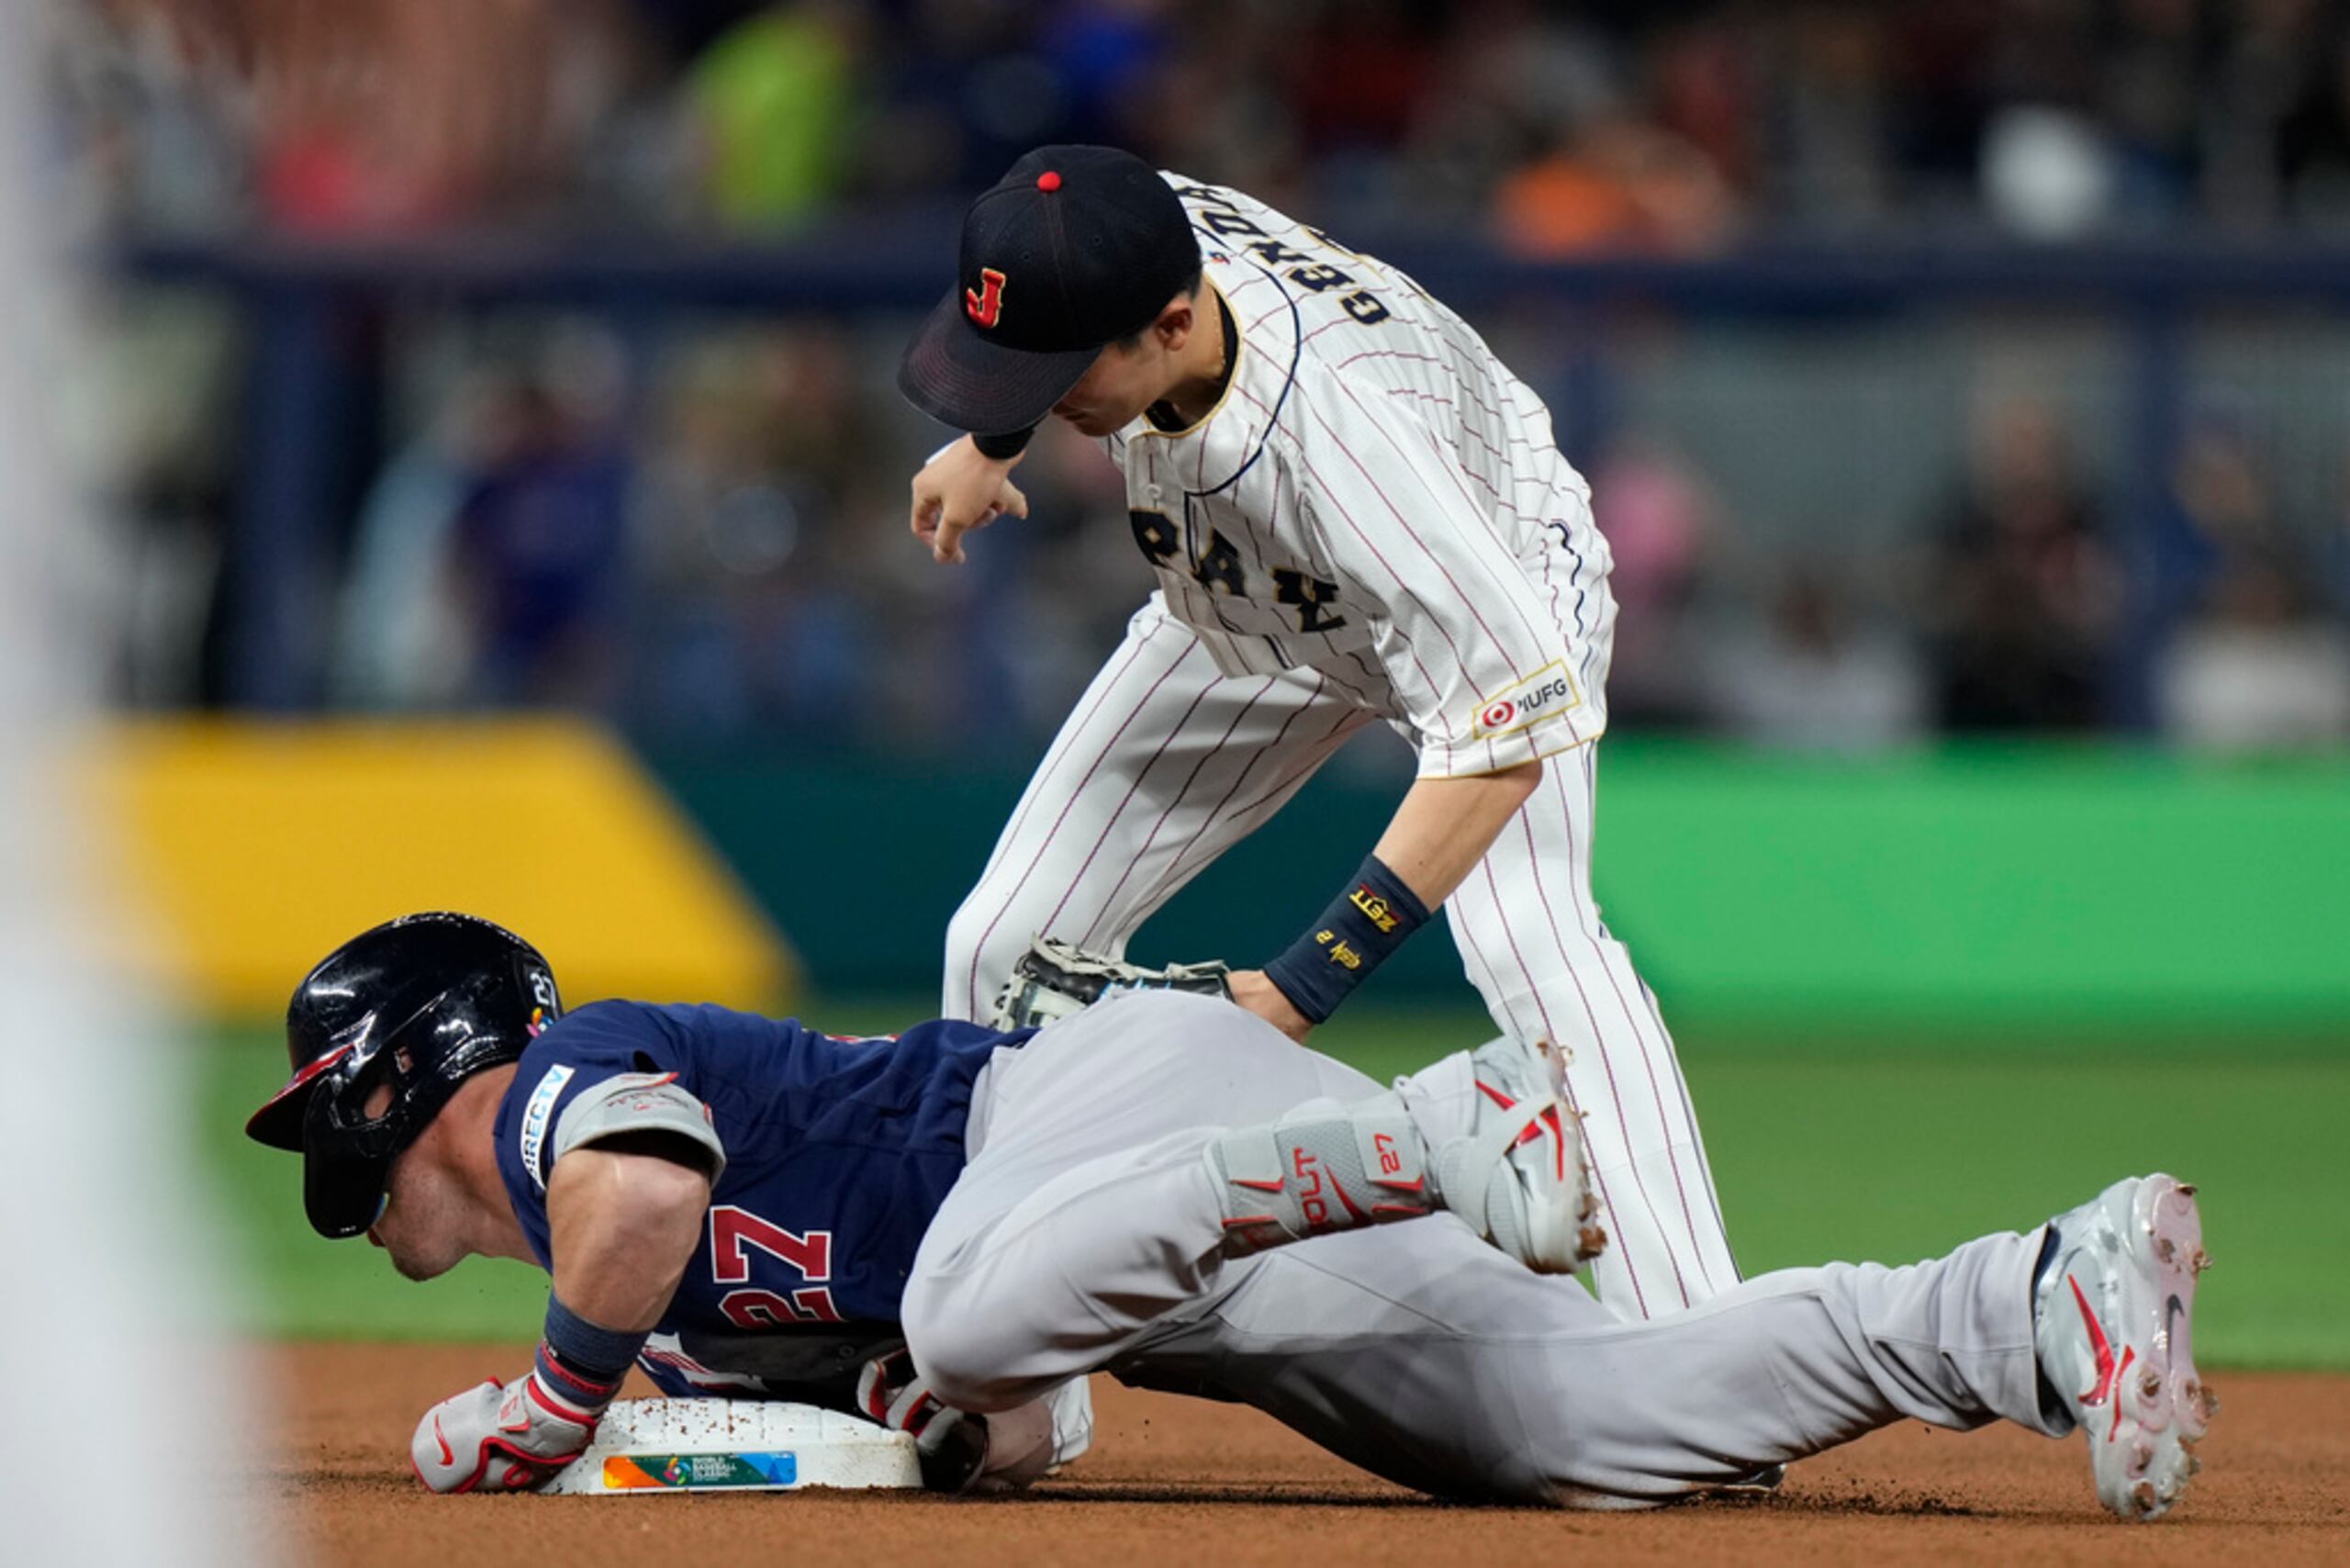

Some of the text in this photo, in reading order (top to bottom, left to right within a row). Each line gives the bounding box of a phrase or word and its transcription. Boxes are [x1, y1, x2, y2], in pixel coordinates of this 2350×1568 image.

[966, 266, 1006, 329] J
[1348, 890, 1397, 933] ZETT
[1374, 1133, 1401, 1174] 27
[710, 1204, 846, 1330] 27
